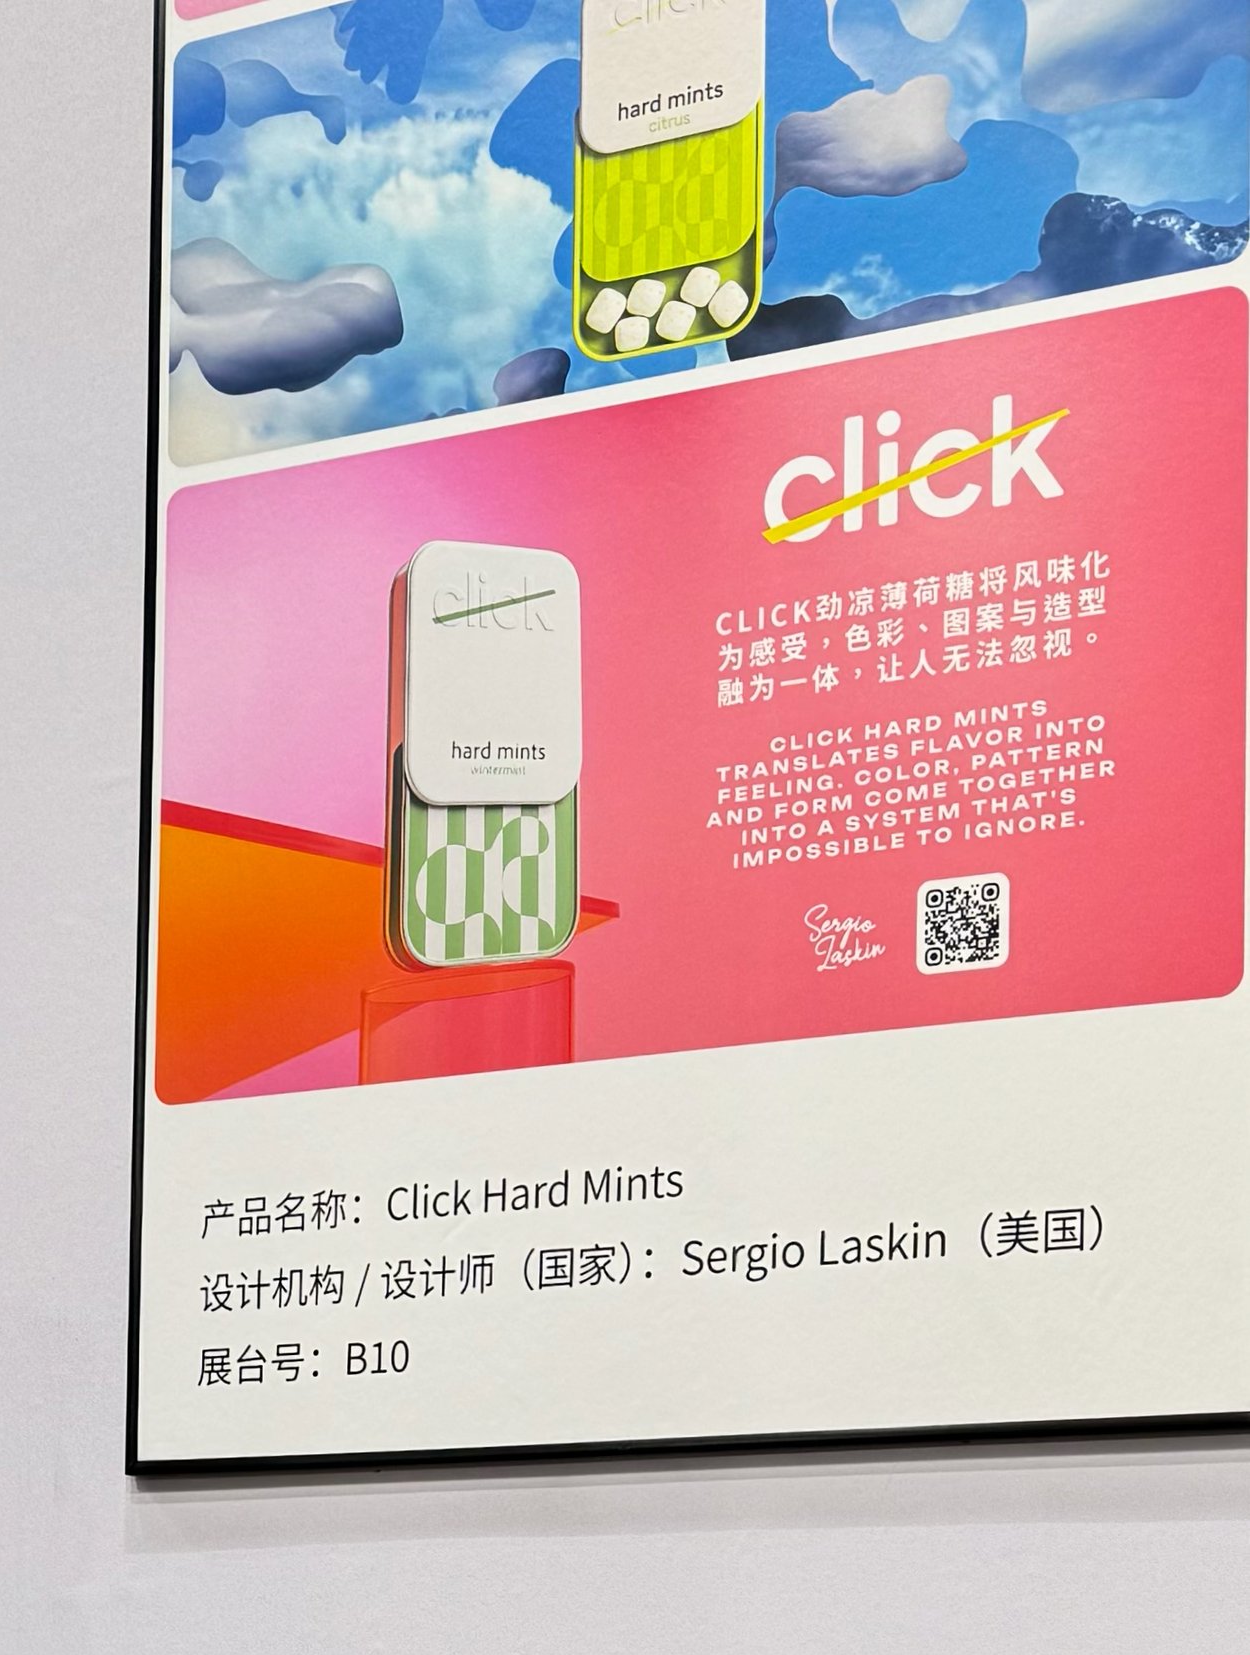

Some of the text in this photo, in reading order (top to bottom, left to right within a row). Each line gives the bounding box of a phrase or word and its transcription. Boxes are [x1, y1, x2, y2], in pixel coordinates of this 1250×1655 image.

[617, 82, 724, 121] hard mints
[648, 111, 691, 133] citrus
[762, 394, 1068, 545] click
[715, 551, 1111, 637] CLICK劲凉薄荷糖将风味化
[716, 629, 1100, 708] 融为一体，让人无法忽视。
[451, 740, 546, 761] hard mints
[716, 714, 1107, 783] TRANSLATES FLAVOR INTO
[769, 699, 1049, 754] CLICK HARD MINTS
[706, 759, 1117, 829] AND FORM COME TOGETHER
[717, 736, 1105, 805] FEELING. COLOR, PATTERN
[732, 810, 1086, 869] IMPOSSIBLE TO IGNORE.
[740, 787, 1078, 847] INTO A SYSTEM THAT'S
[803, 903, 878, 948] Sergio
[201, 1166, 684, 1240] 产品名称： Click Hard Mints
[200, 1263, 345, 1312] 设计机构
[354, 1262, 371, 1308] /
[681, 1233, 806, 1283] Sergio
[818, 1221, 947, 1266] Laskin
[197, 1340, 410, 1387] 展台号： B10
